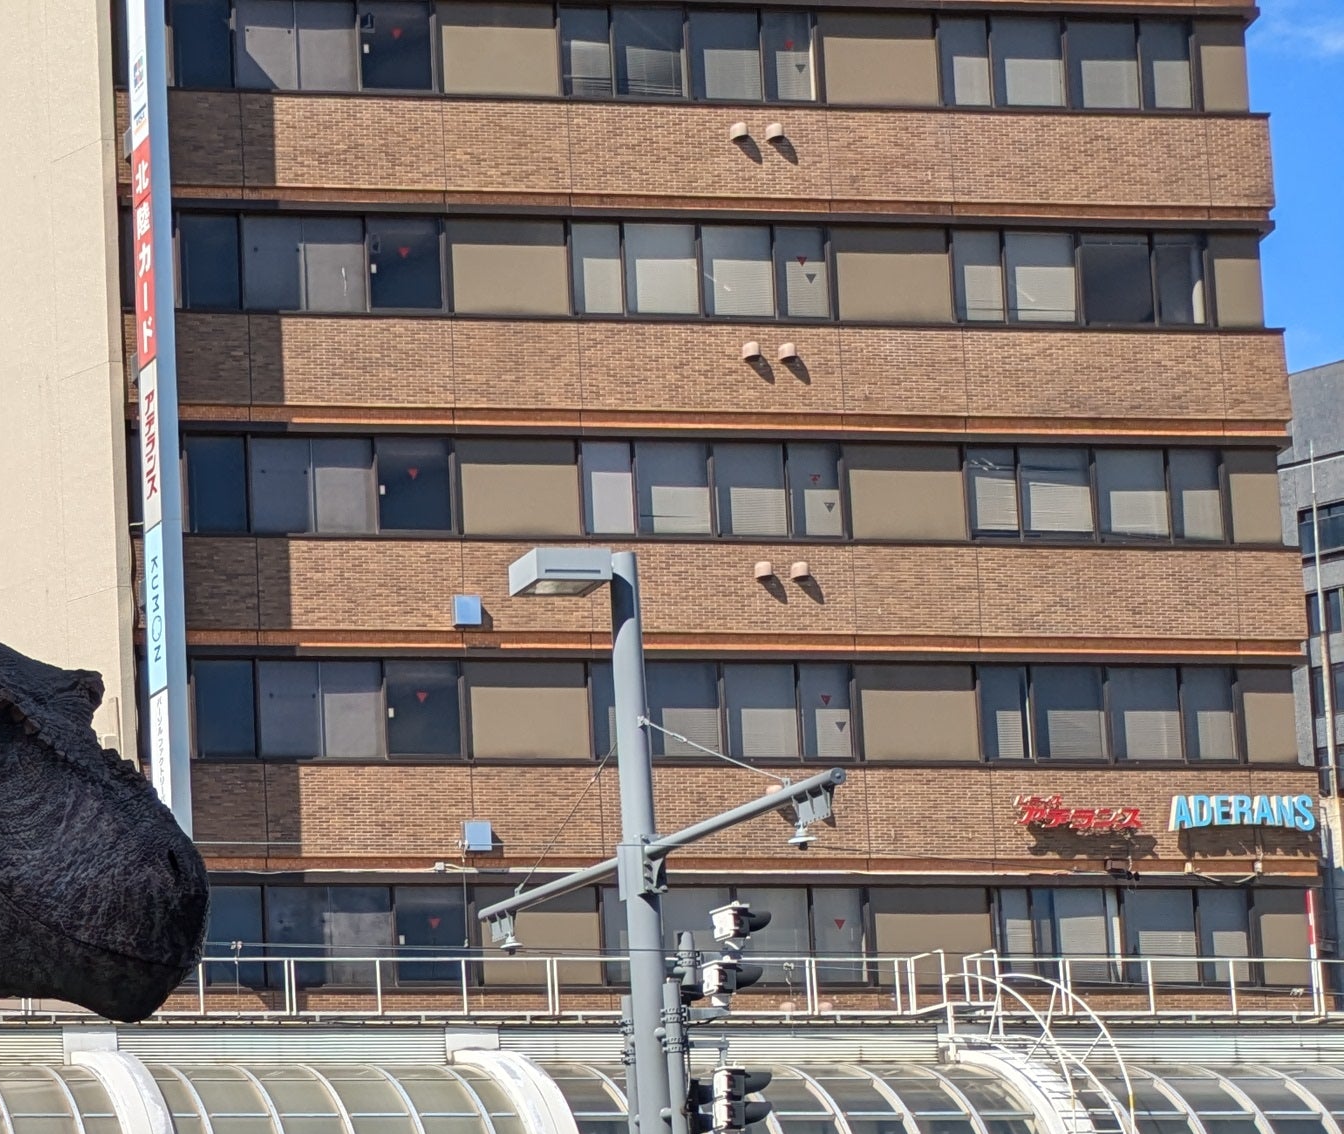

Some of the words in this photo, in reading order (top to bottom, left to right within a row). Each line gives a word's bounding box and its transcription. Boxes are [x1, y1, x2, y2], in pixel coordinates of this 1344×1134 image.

[135, 160, 152, 354] 北陸カード
[144, 388, 158, 500] アデランス
[150, 555, 163, 663] KUMON
[1014, 806, 1143, 828] アデランス
[1169, 794, 1316, 832] ADERANS
